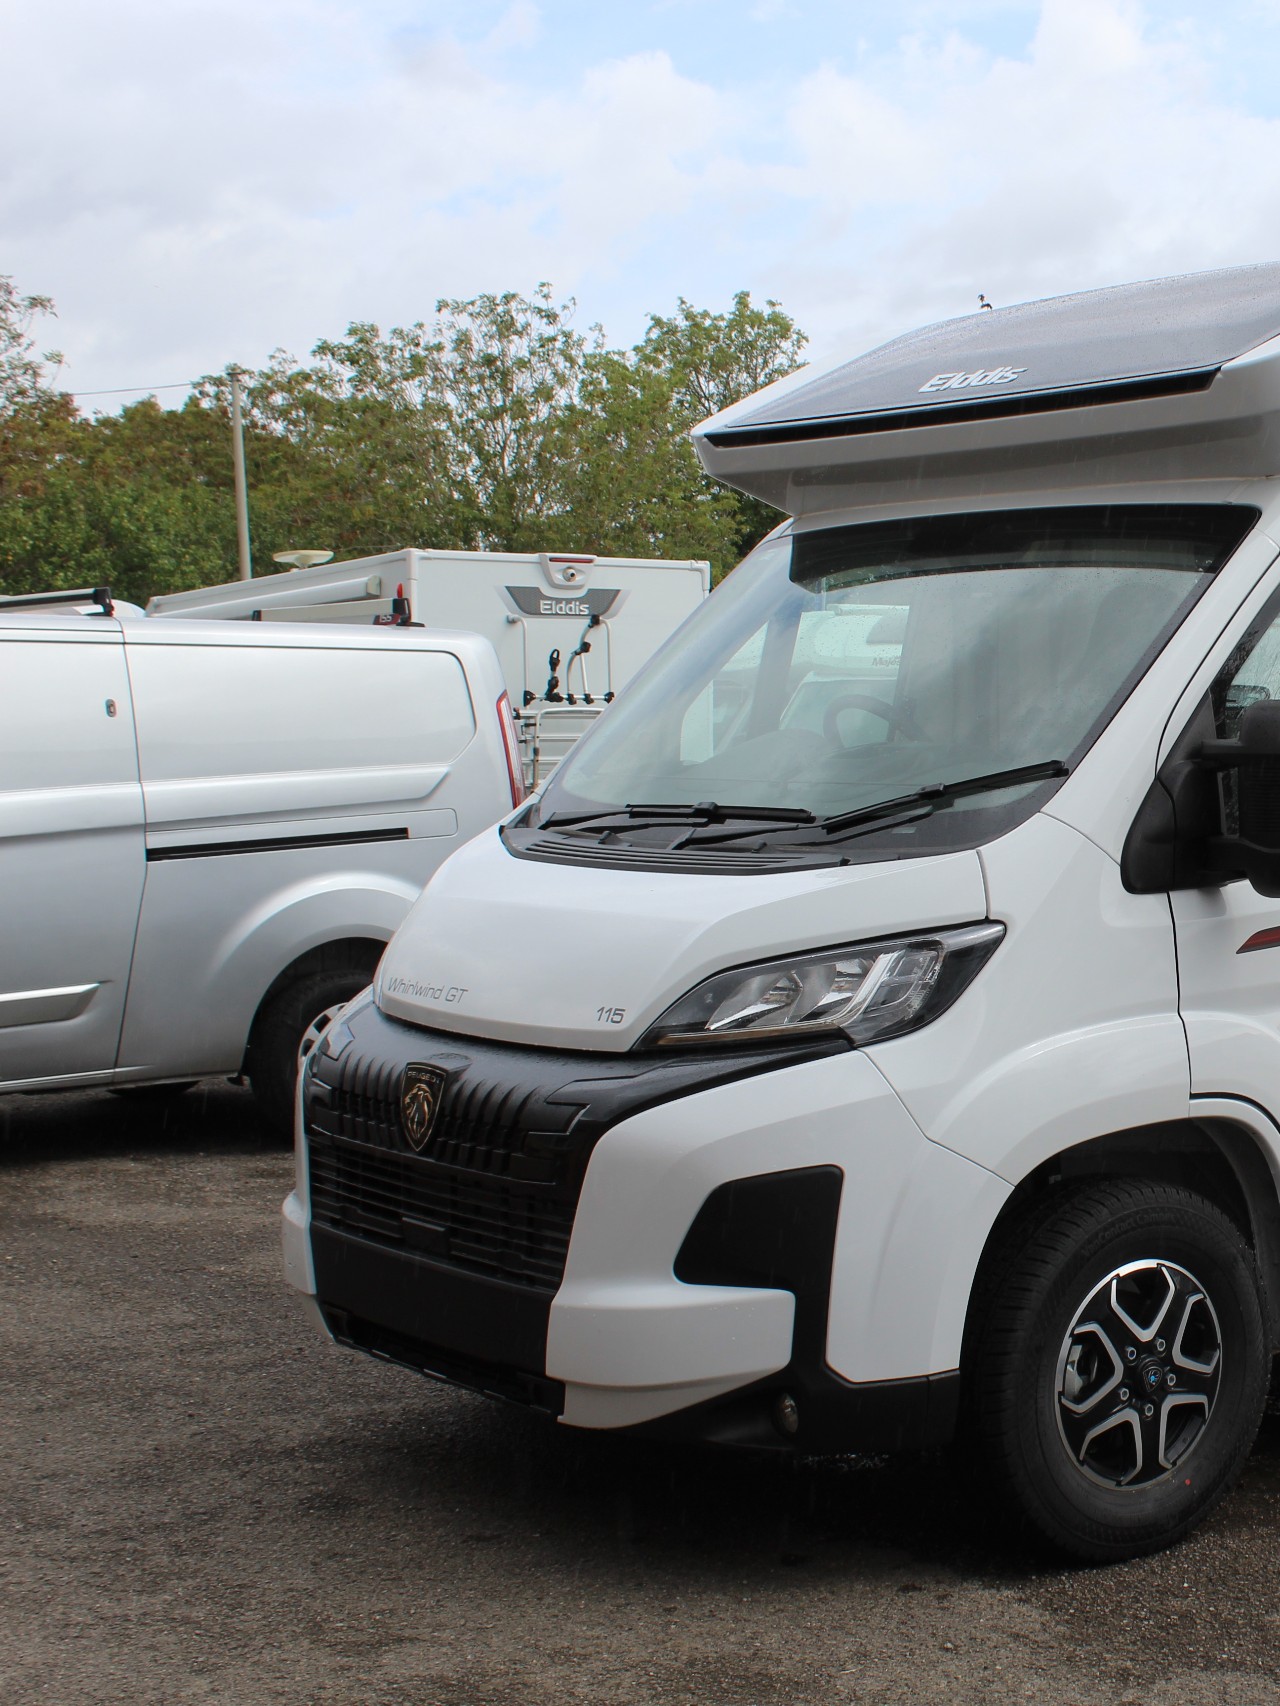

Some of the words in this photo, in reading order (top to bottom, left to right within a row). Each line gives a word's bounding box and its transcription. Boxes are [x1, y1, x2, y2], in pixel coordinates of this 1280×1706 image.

[918, 366, 1028, 393] Elddis
[540, 600, 590, 614] Elddis
[388, 977, 445, 1000] Whirlwind
[444, 986, 469, 1004] GT
[597, 1006, 626, 1024] 115
